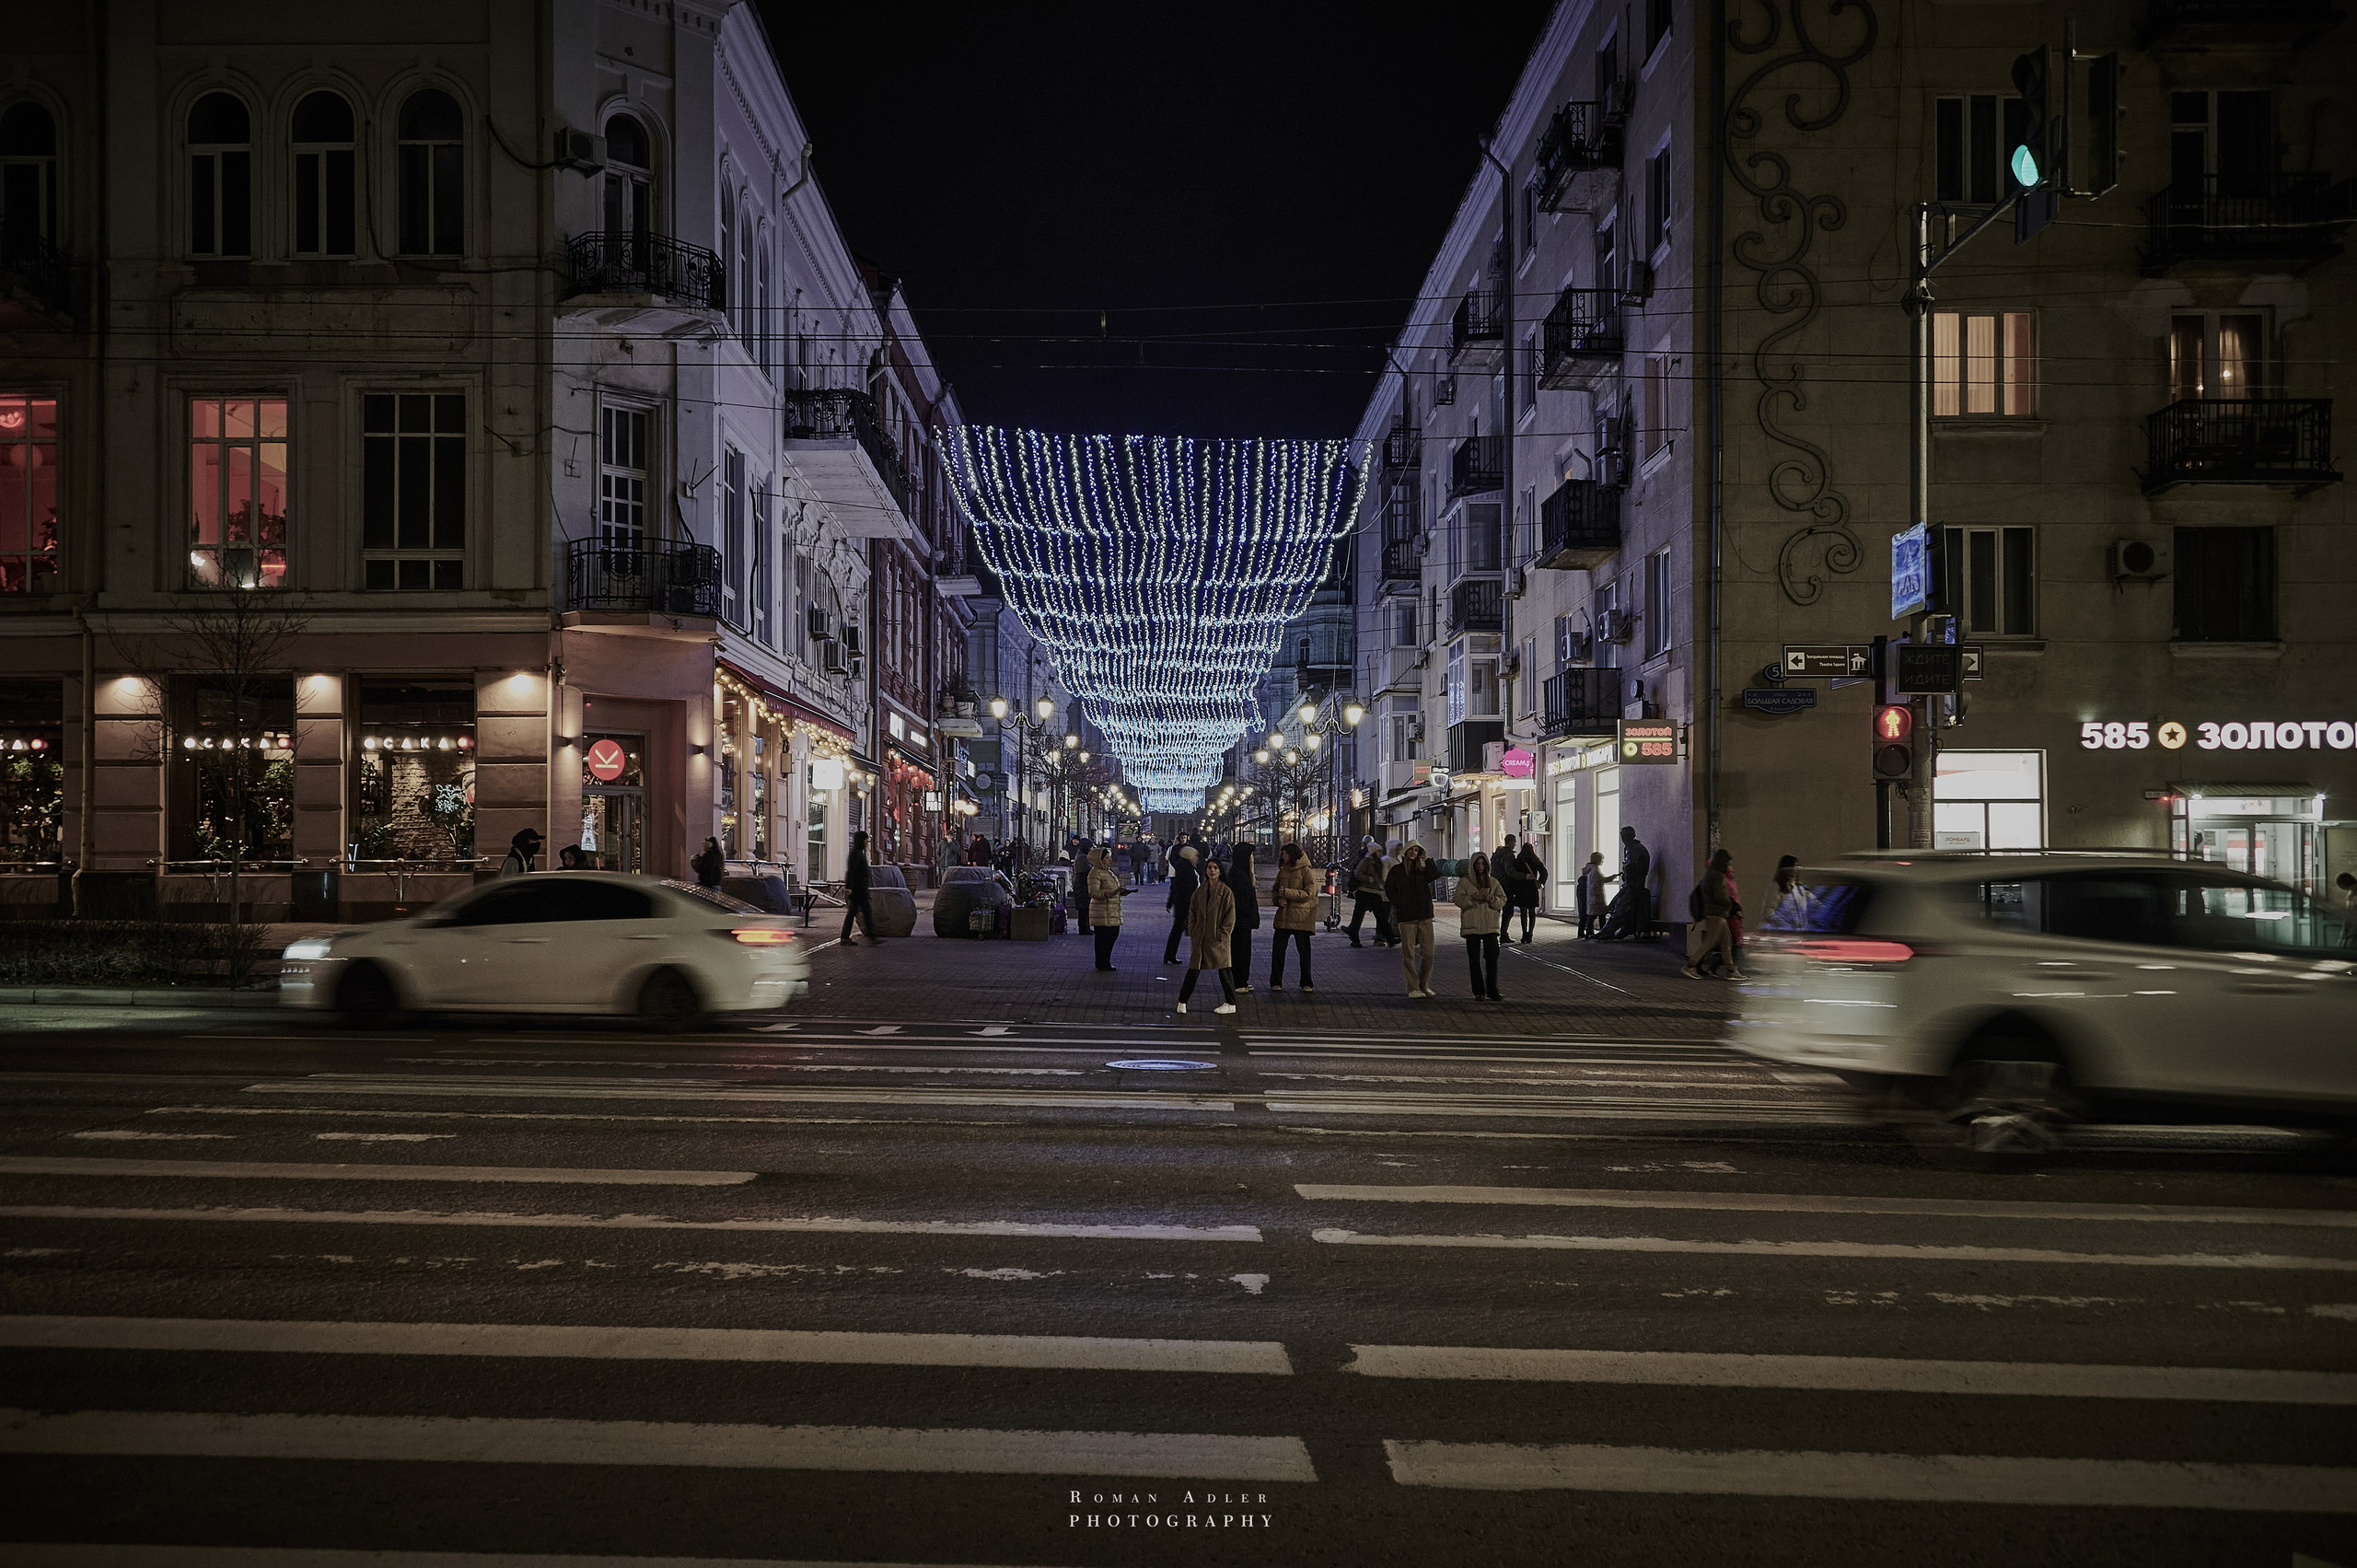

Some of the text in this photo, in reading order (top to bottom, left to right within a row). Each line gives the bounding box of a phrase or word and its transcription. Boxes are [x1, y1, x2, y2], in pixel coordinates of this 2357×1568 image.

[1904, 654, 1950, 665] ЖДИТЕ
[1772, 667, 1780, 678] 5
[1904, 674, 1951, 685] ИДИТЕ
[1624, 726, 1673, 737] ЗОЛОТОЙ
[2080, 721, 2357, 750] 585 ЗОЛОТО
[1642, 742, 1673, 757] 585
[1504, 760, 1530, 769] CREAMS
